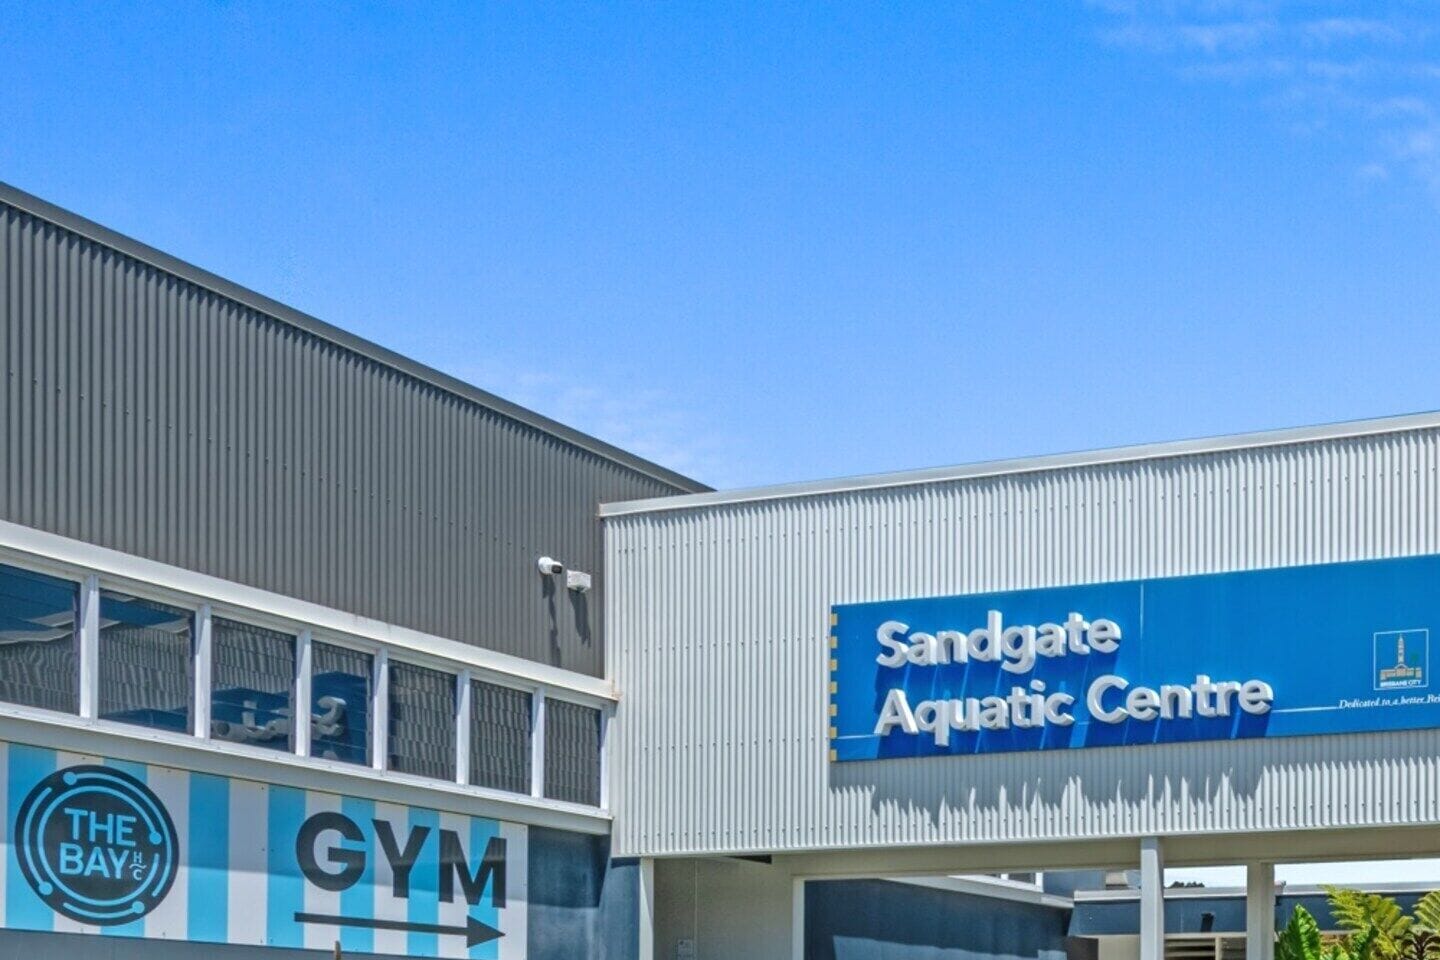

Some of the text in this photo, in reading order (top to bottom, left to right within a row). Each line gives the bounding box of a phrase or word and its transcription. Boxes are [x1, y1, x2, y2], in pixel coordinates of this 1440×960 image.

[876, 609, 1121, 674] Sandgate
[874, 674, 1273, 746] Aquatic Centre
[1339, 697, 1380, 708] Dedicated
[64, 807, 137, 847] THE
[60, 842, 130, 879] BAY
[296, 811, 507, 909] GYM
